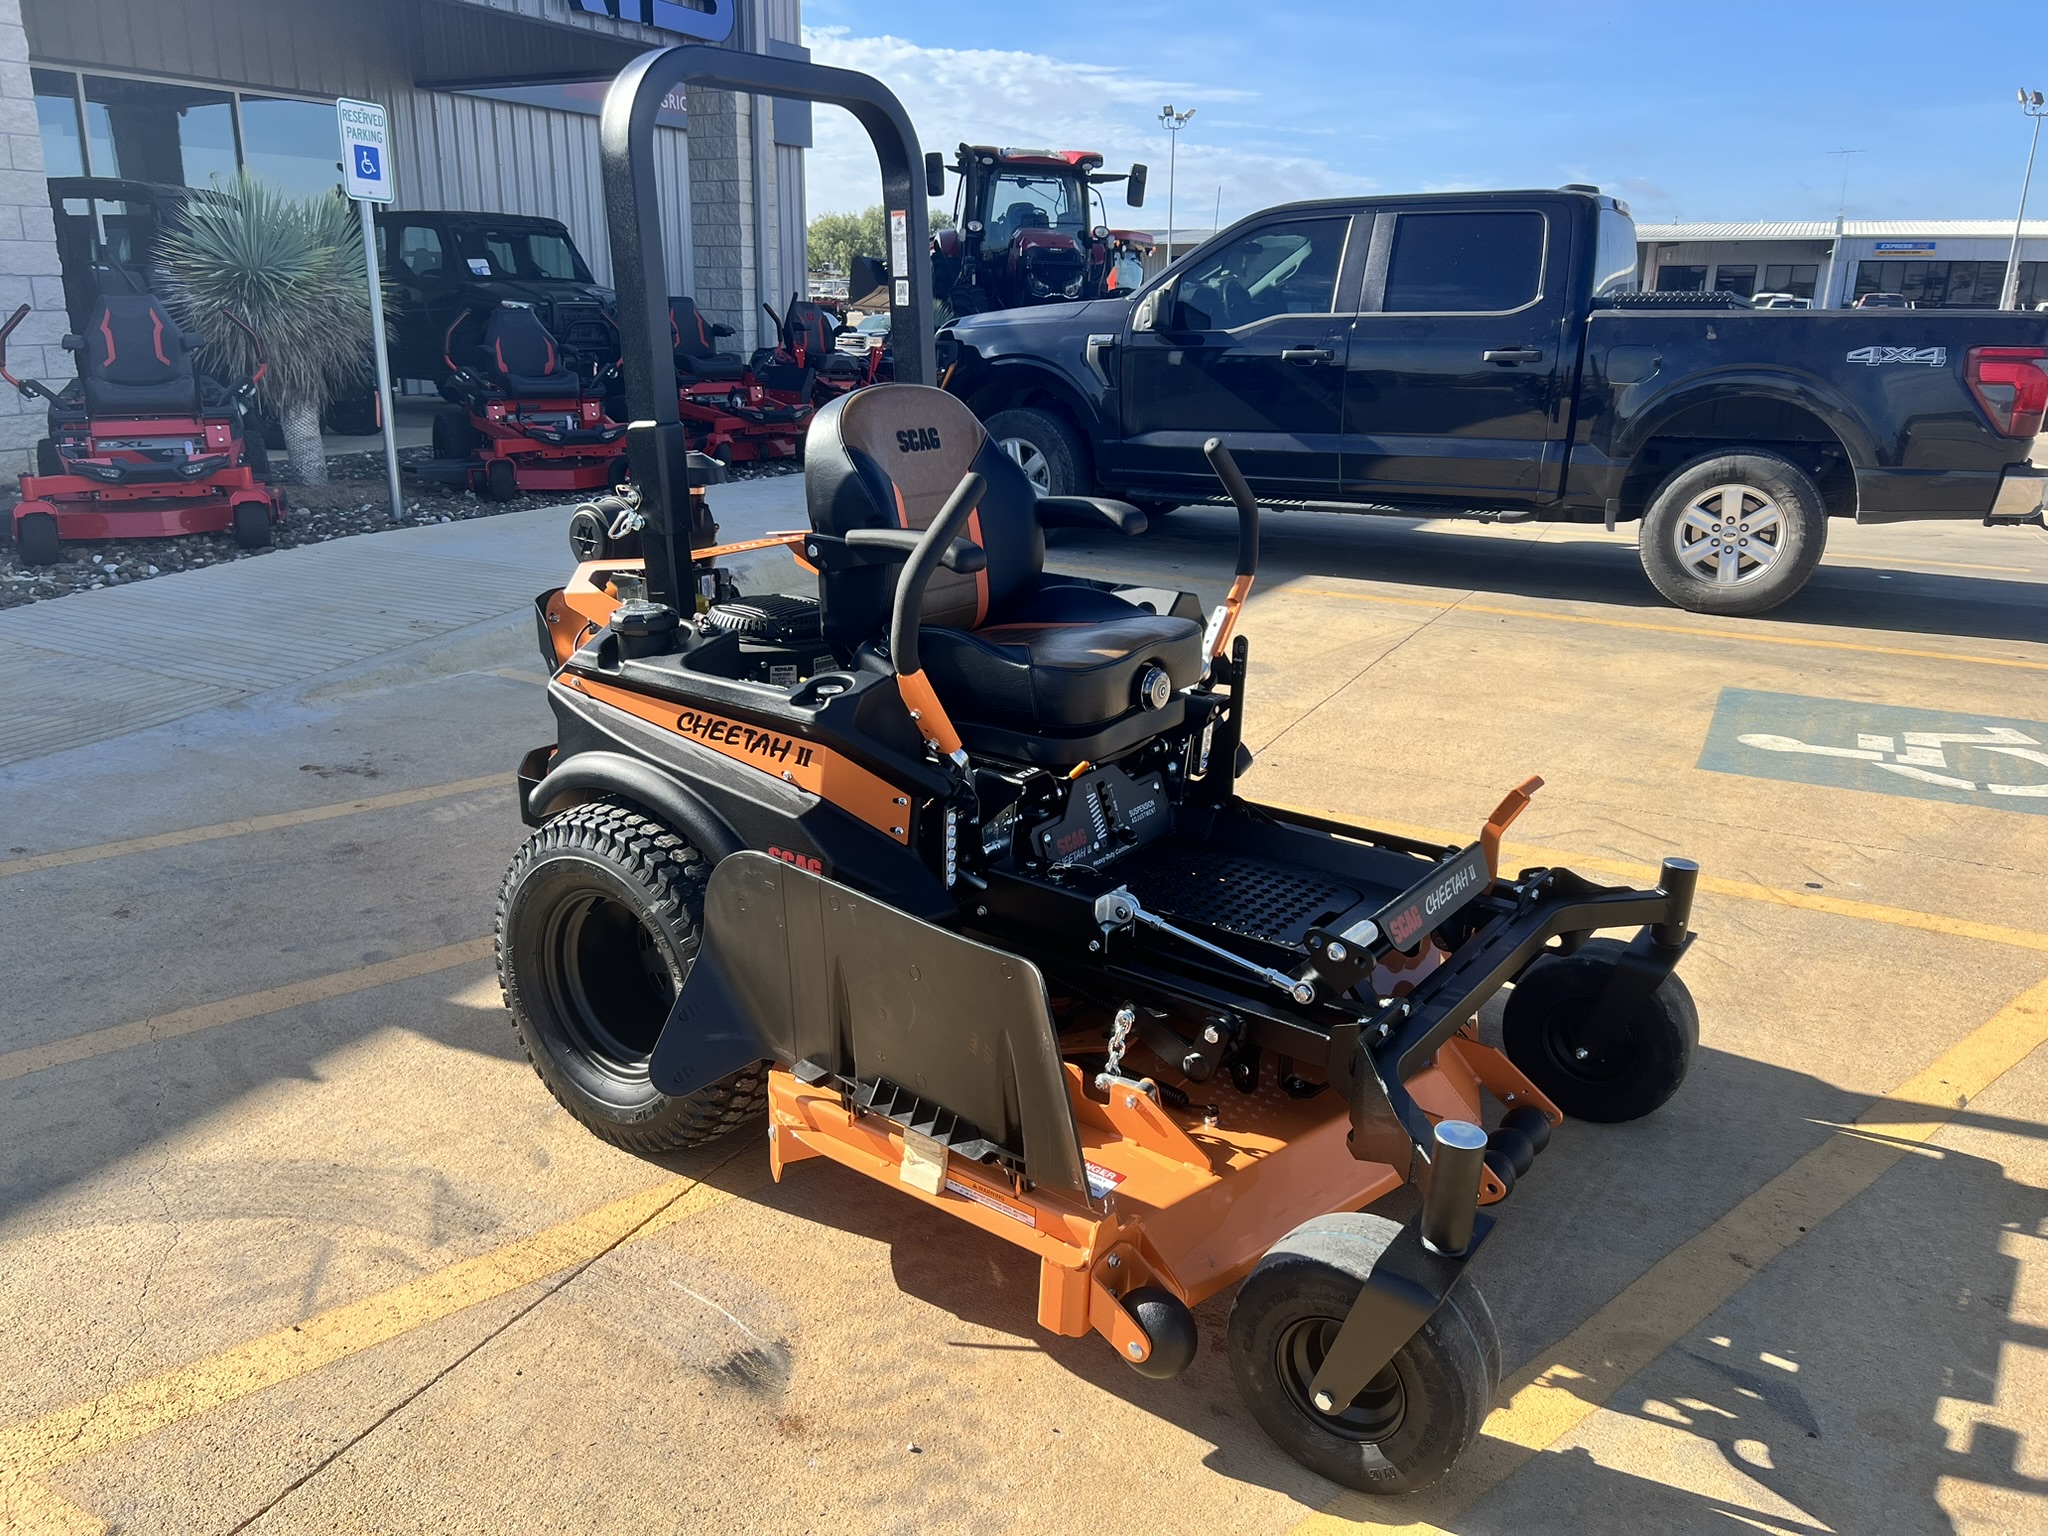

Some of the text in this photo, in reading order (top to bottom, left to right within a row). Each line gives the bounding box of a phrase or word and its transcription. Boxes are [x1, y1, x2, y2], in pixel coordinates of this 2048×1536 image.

[341, 108, 384, 128] RESERVED
[346, 126, 383, 144] PARKING
[896, 427, 942, 453] SCAG
[676, 711, 814, 768] CHEETAH II
[1128, 799, 1156, 818] SUSPENSION
[1131, 806, 1157, 824] ADJUSTMENT
[1056, 828, 1087, 854] SCAG
[1059, 847, 1087, 865] HEETAH
[1389, 864, 1477, 944] SCAG CHEETAH II
[1084, 1162, 1117, 1180] NGER
[978, 1185, 1005, 1202] WARNING
